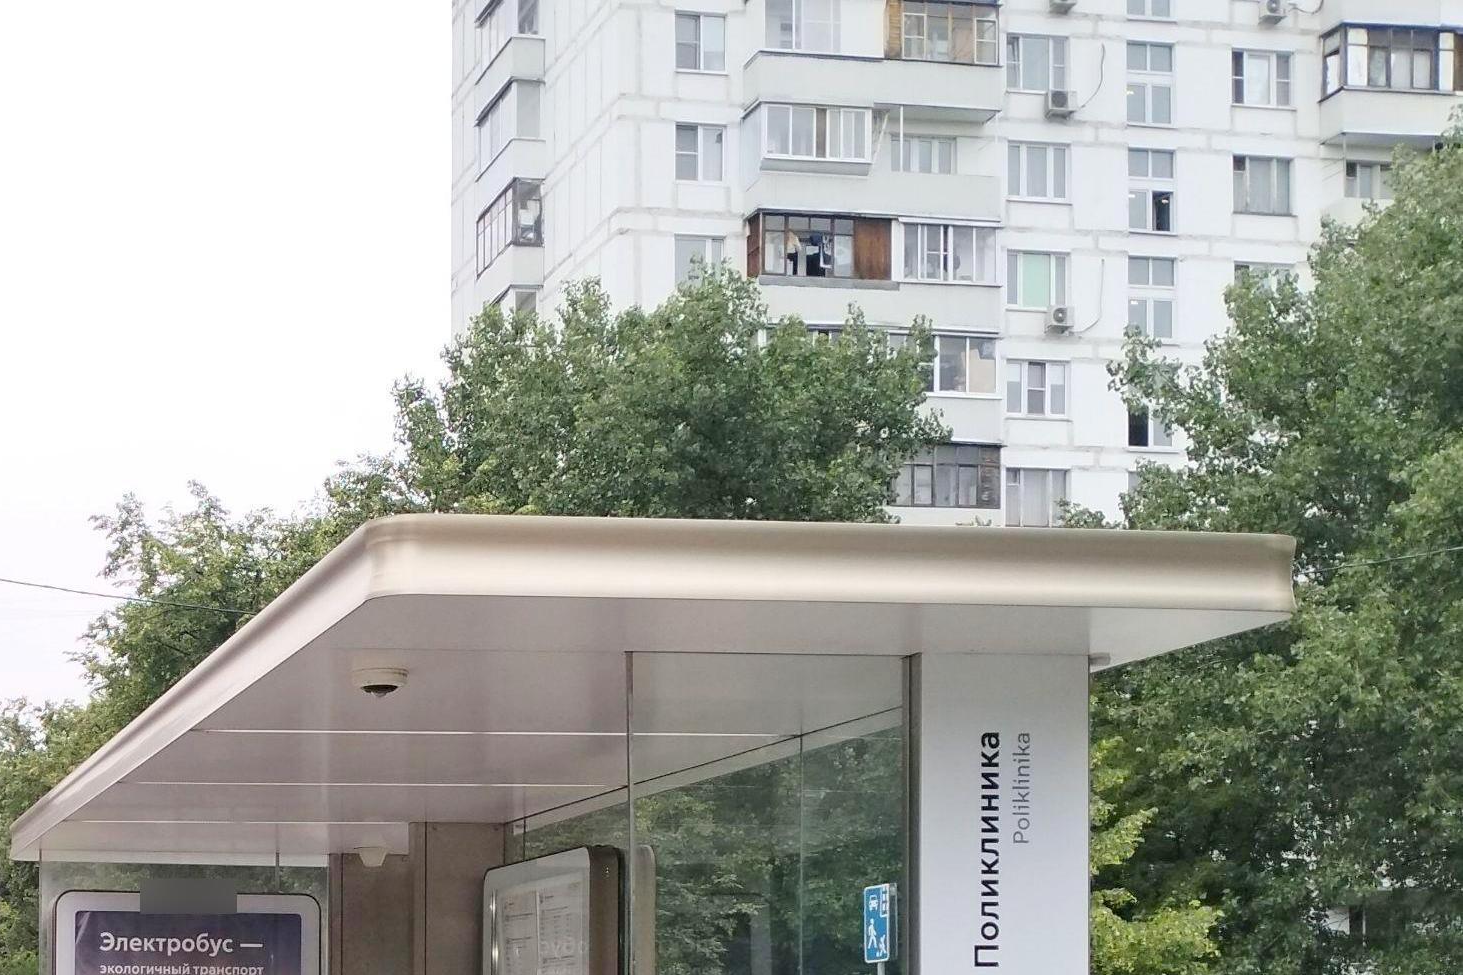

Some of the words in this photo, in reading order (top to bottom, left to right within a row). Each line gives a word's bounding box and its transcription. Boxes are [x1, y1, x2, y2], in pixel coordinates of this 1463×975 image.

[1012, 732, 1031, 844] Poliklinika
[974, 731, 1001, 968] Поликлиника
[99, 931, 234, 956] Электробус
[99, 963, 190, 975] экологичный
